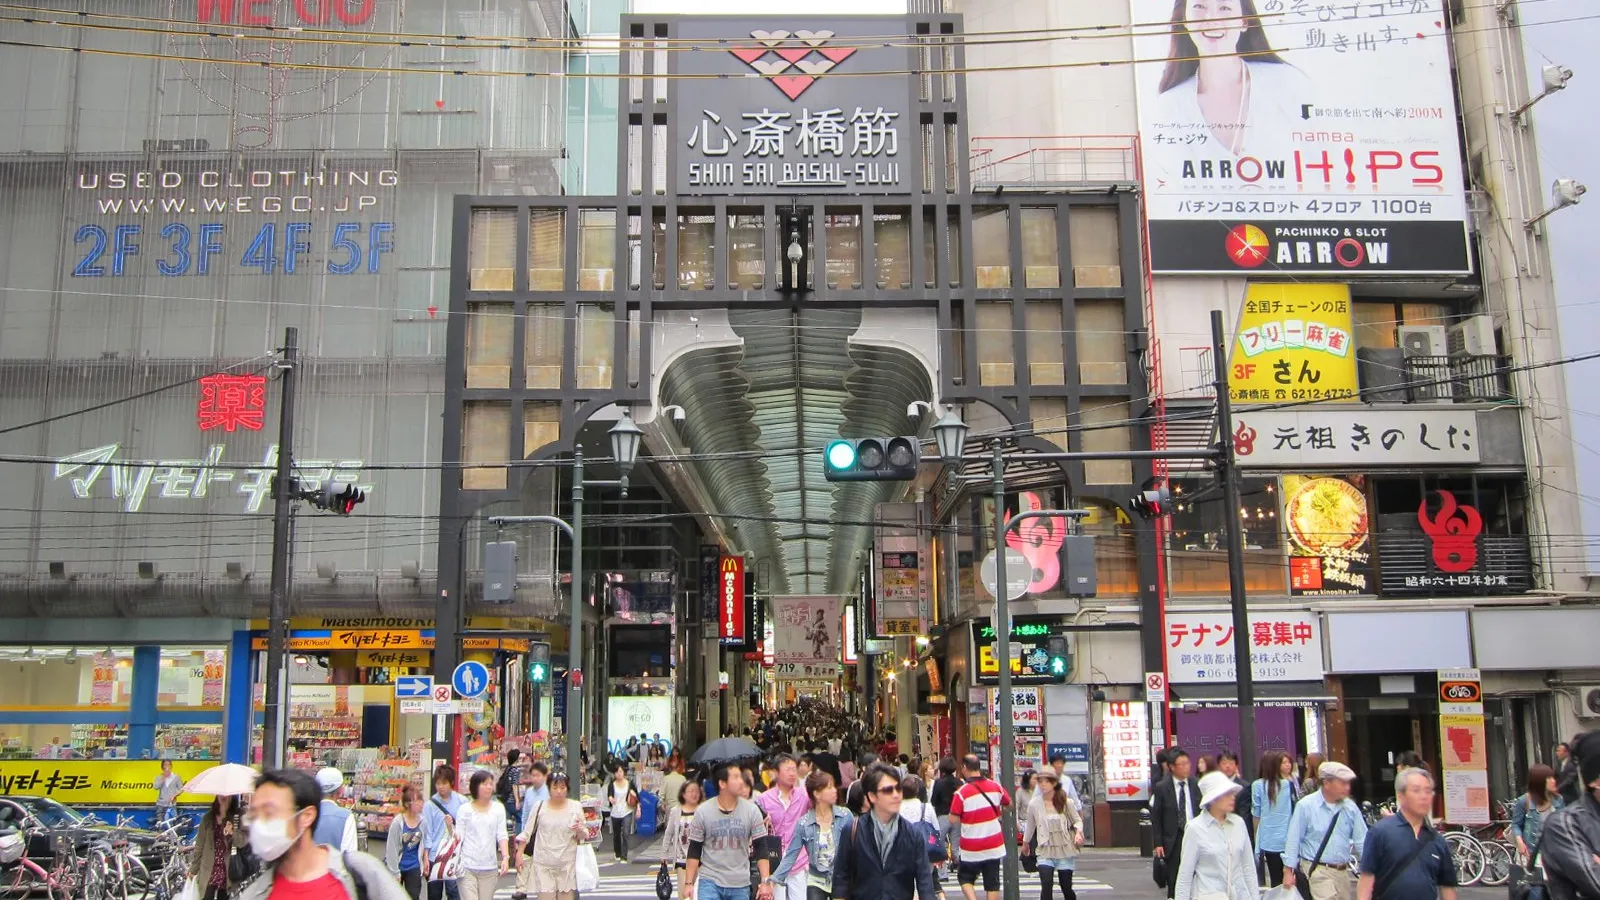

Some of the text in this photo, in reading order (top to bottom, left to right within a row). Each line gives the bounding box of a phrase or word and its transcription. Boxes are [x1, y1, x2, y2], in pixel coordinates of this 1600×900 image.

[1305, 24, 1410, 53] 動き出す。
[687, 107, 899, 157] 心斎橋筋
[1152, 133, 1208, 145] チェ・ジウ
[79, 169, 399, 190] USED CLOTHING
[689, 162, 734, 184] SHIN
[1182, 156, 1286, 183] ARROW
[1371, 199, 1433, 214] 1100台
[1275, 227, 1388, 237] PACHINKO & SLOT
[71, 222, 397, 278] 2F 3F 4F 5F
[1276, 238, 1389, 268] ARROW
[1246, 300, 1348, 314] 全国チェーンの店
[1244, 322, 1348, 352] フリー麻雀
[1234, 359, 1321, 384] 3F さん
[199, 374, 267, 432] 薬
[1405, 574, 1508, 587] 昭和六十四年創業
[724, 572, 736, 637] McDonald's
[339, 631, 411, 648] マツモトキヨシ
[1169, 621, 1313, 648] テナン募集中
[1180, 651, 1304, 666] 御堂筋都市発株式会社
